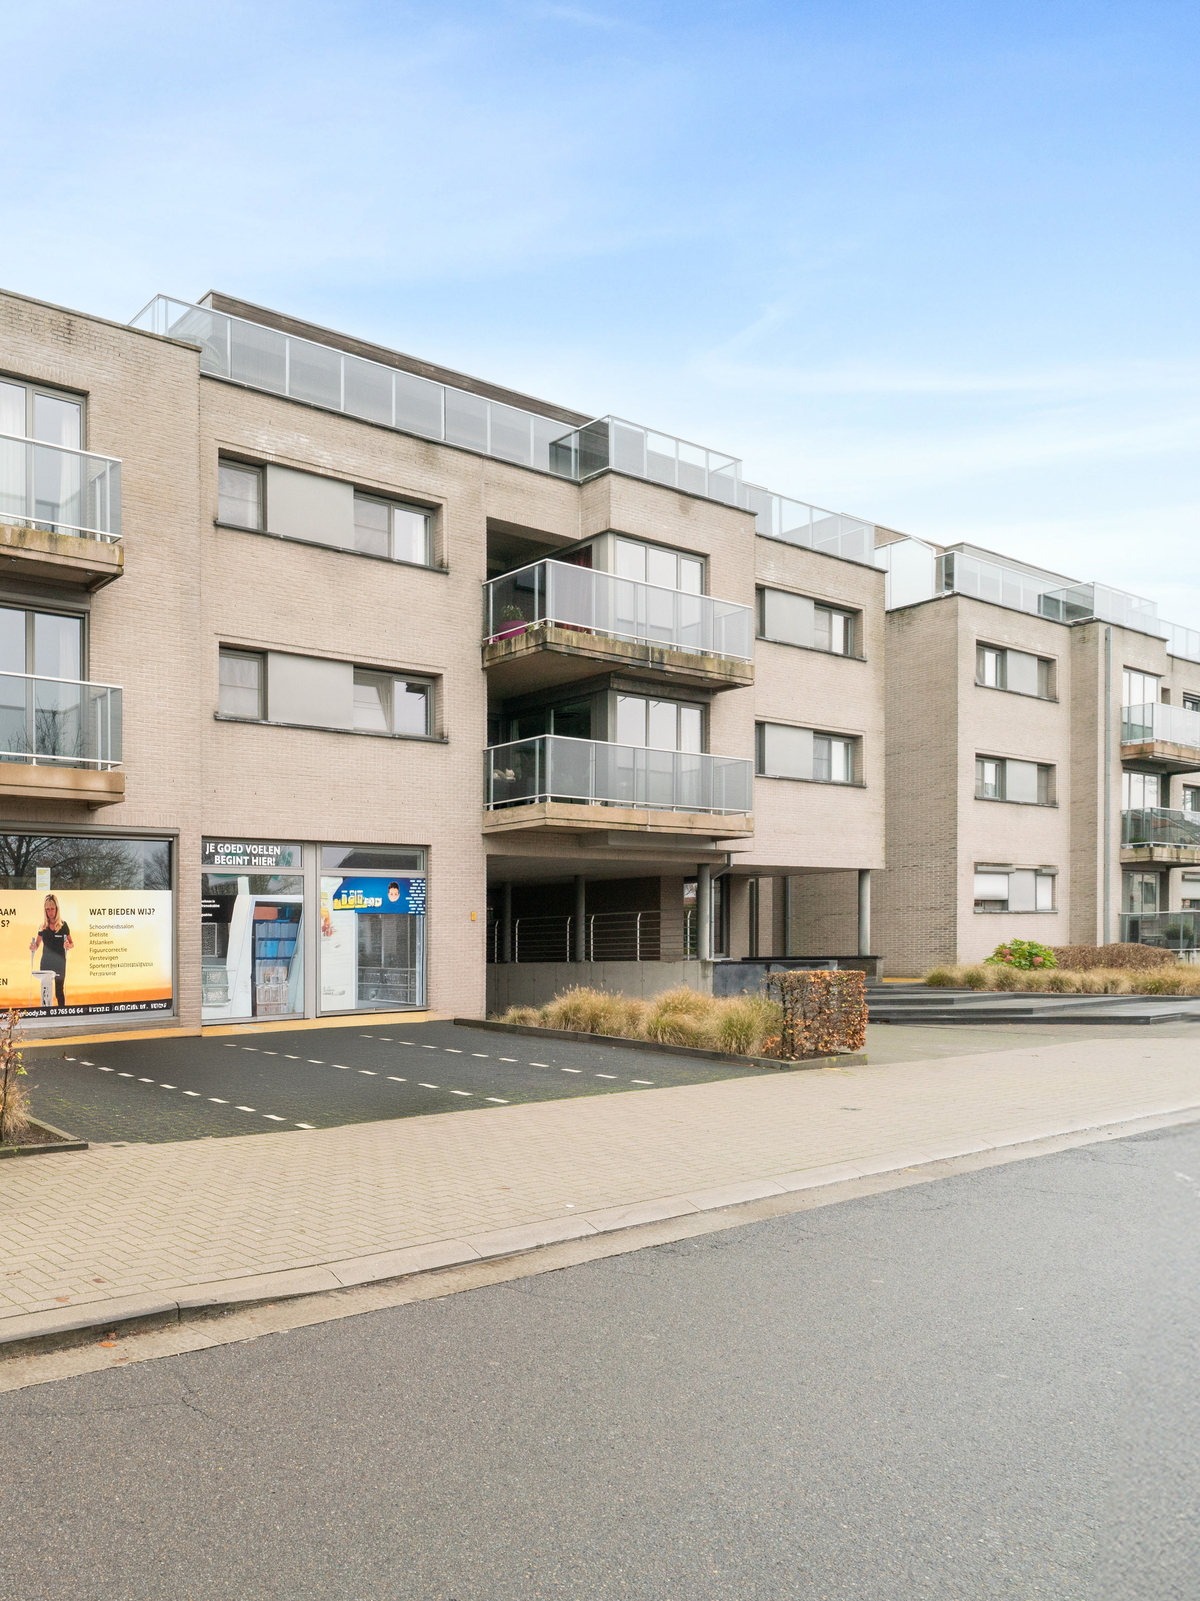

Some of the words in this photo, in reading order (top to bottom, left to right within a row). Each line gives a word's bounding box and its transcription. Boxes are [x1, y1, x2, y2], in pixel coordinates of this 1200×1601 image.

[205, 843, 215, 854] JE
[217, 843, 243, 853] GOED
[245, 844, 281, 855] VOELEN
[214, 855, 249, 865] BEGINT
[251, 856, 276, 866] HIER!
[89, 908, 106, 916] WAT
[108, 908, 136, 916] BIEDEN
[137, 908, 156, 916] WIJ?
